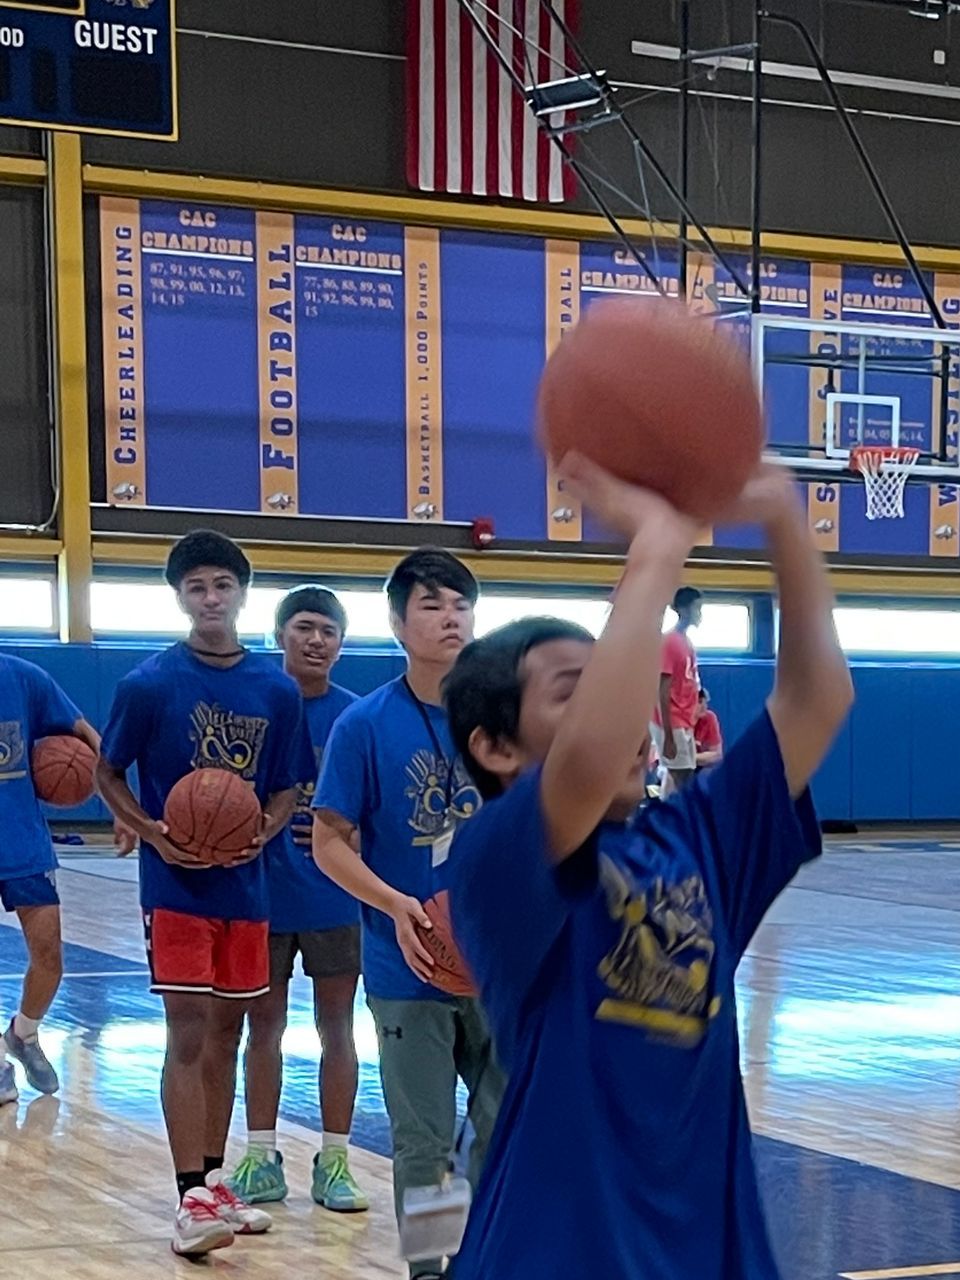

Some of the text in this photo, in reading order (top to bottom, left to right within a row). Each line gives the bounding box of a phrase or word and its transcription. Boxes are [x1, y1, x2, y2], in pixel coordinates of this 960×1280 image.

[74, 19, 158, 55] GUEST
[179, 209, 217, 228] CAC
[331, 223, 367, 242] CAC
[142, 231, 254, 256] CHAMPIONS
[296, 245, 402, 270] CHAMPIONS
[416, 261, 428, 320] POINTS
[872, 272, 903, 289] CAC
[114, 226, 137, 465] CHEERLEADING
[262, 244, 295, 470] FOOTBALL
[418, 393, 430, 495] BASKETBALL
